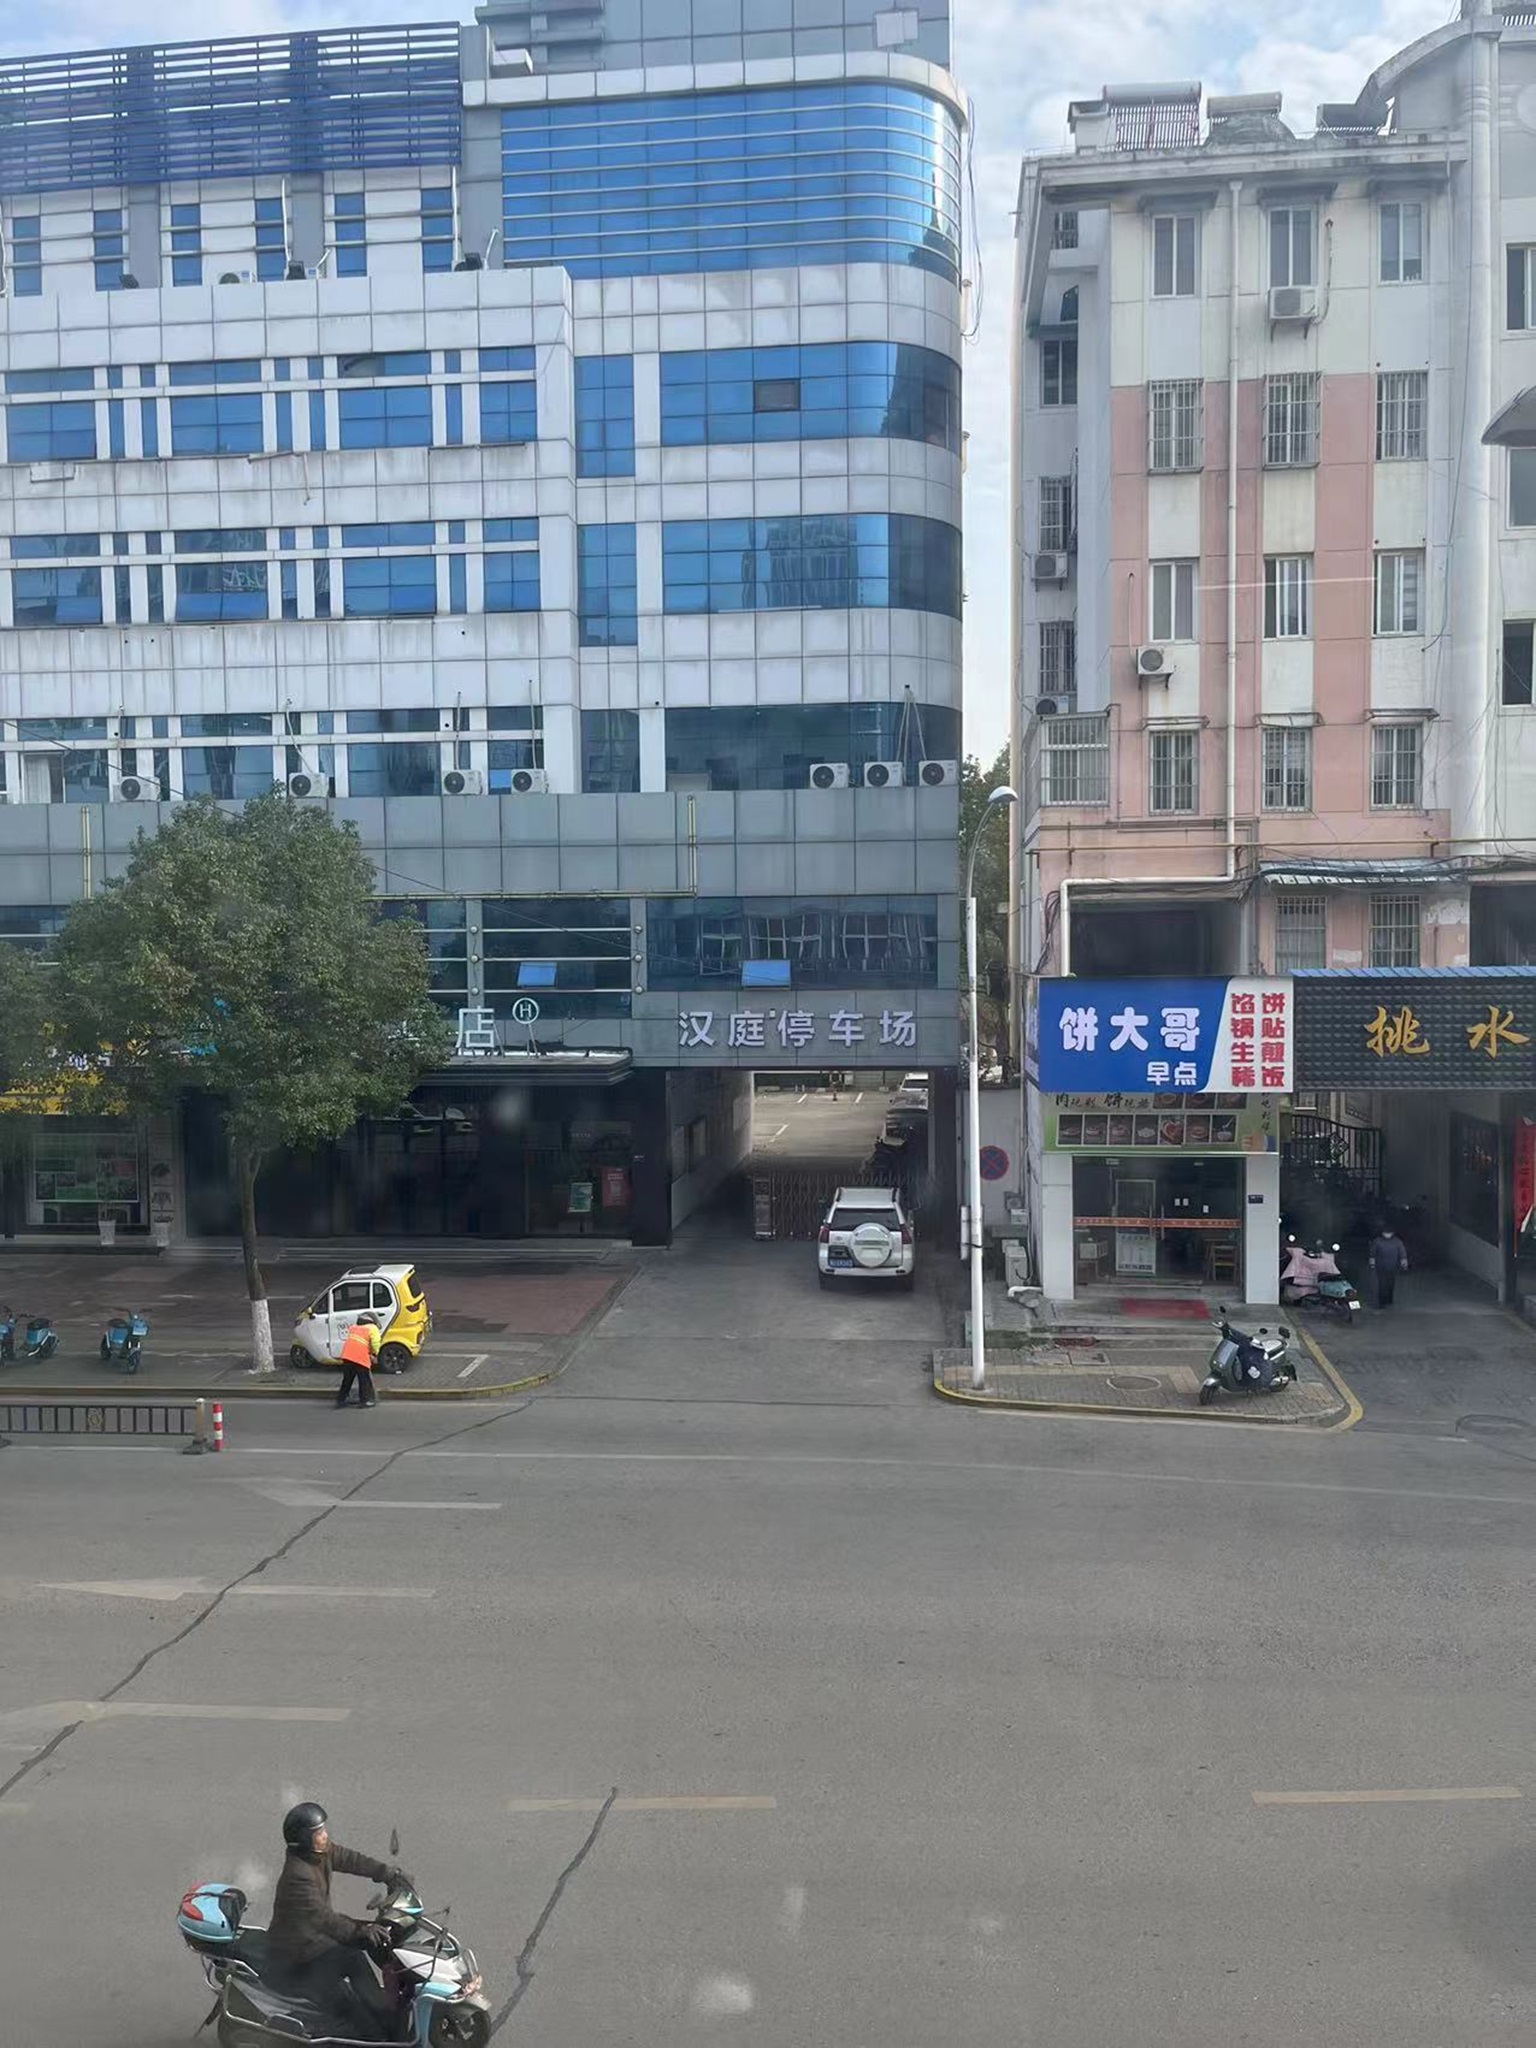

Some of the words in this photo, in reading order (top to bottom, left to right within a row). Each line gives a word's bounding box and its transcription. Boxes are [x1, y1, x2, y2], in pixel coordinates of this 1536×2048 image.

[1231, 993, 1285, 1014] 馅饼
[678, 1010, 917, 1048] 汉庭停车场
[1060, 1007, 1200, 1051] 饼大哥
[1231, 1017, 1285, 1038] 锅贴
[1231, 1042, 1285, 1063] 生煎
[1147, 1062, 1197, 1086] 早点
[1231, 1066, 1285, 1087] 稀饭
